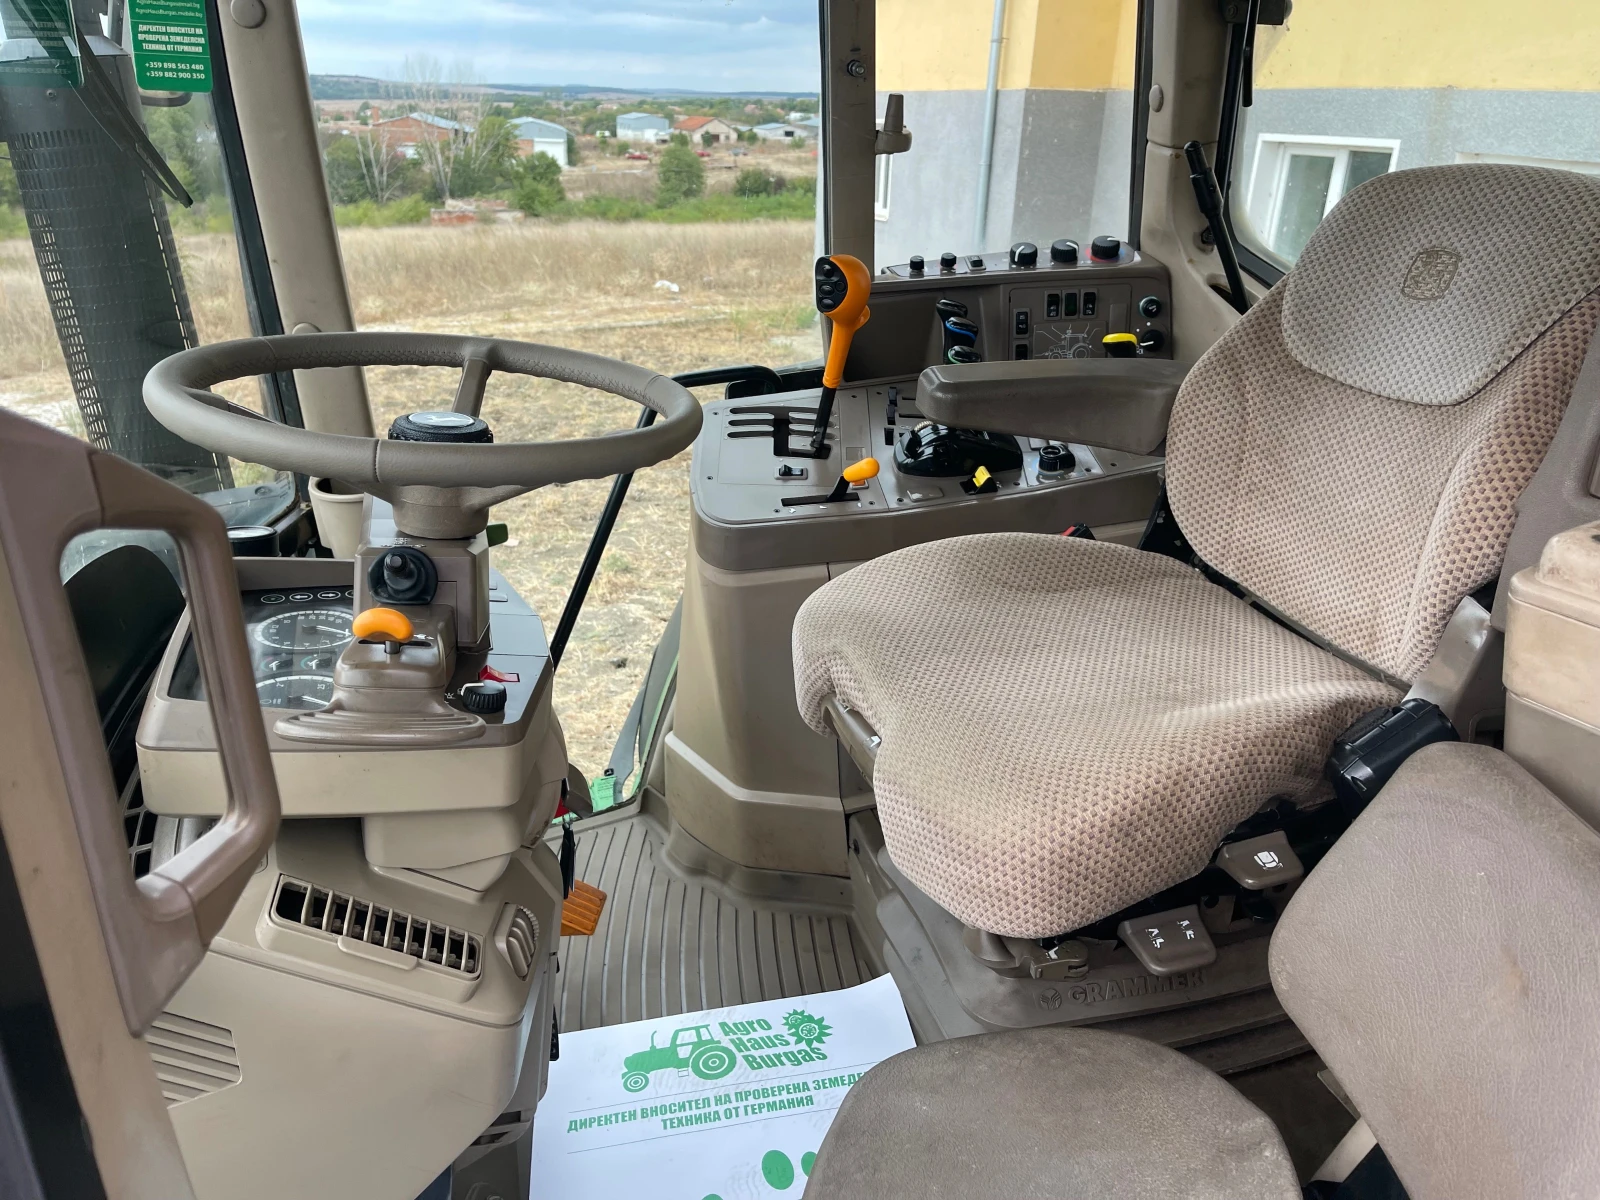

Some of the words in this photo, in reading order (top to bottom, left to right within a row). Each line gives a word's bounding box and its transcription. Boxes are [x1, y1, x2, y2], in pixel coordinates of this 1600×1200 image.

[166, 26, 195, 34] ВНОСИТЕЛ
[169, 35, 205, 44] ЗЕМЕДЕЛСКА
[174, 45, 203, 53] ГЕРМАНИЯ
[145, 61, 162, 69] +359
[1068, 971, 1204, 1004] GRAMMER
[719, 1018, 773, 1038] Agro
[733, 1033, 791, 1055] Haus
[743, 1047, 828, 1072] Burgas
[567, 1110, 637, 1133] ДИРЕКТЕН
[640, 1097, 711, 1120] ВНОСИТЕЛ
[714, 1094, 732, 1110] НА
[734, 1082, 810, 1103] ПРОВЕРЕНА
[661, 1110, 722, 1131] ТЕХНИКА
[723, 1106, 742, 1120] ОТ
[743, 1094, 814, 1116] ГЕРМАНИЯ
